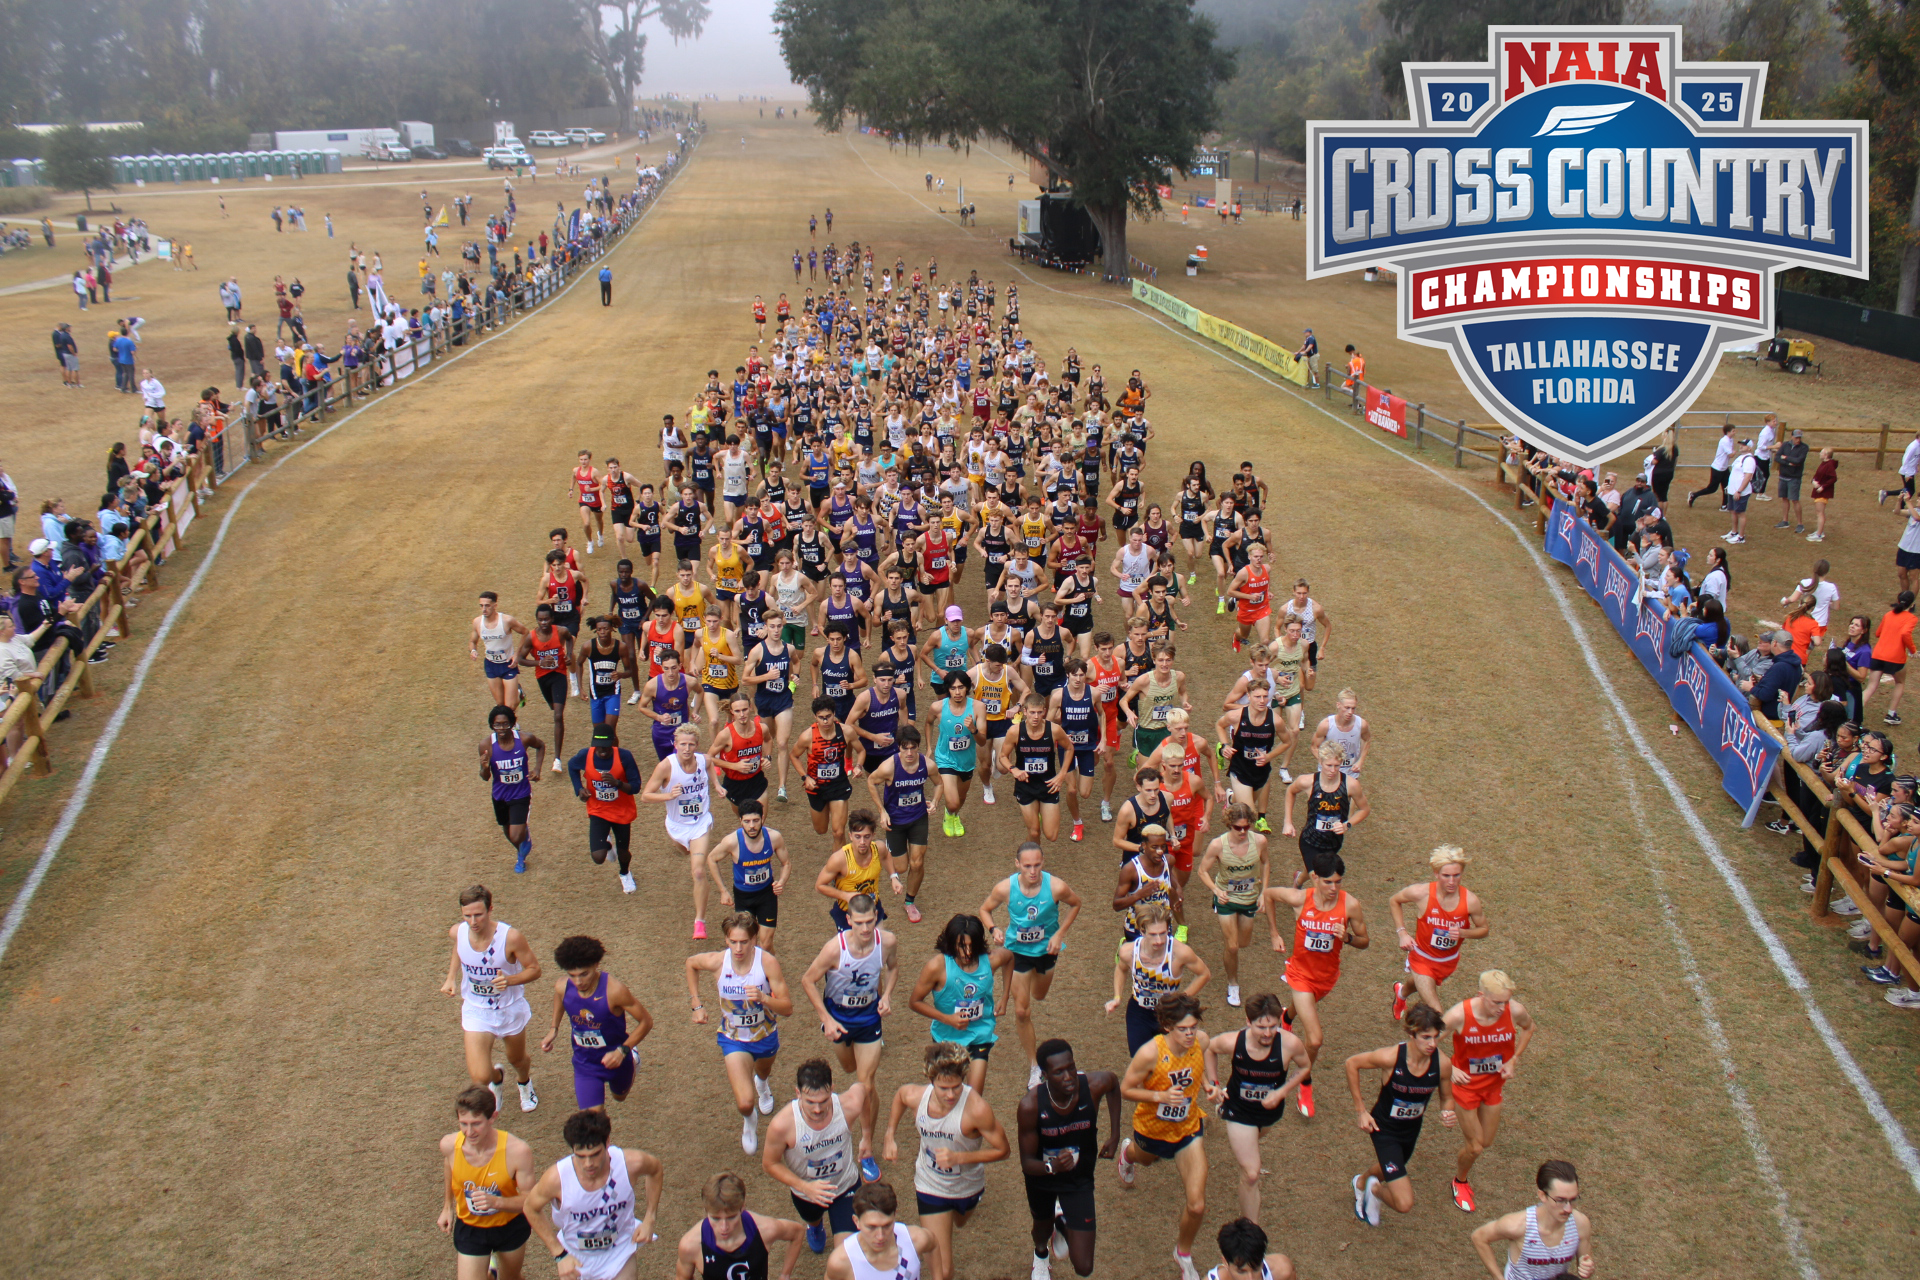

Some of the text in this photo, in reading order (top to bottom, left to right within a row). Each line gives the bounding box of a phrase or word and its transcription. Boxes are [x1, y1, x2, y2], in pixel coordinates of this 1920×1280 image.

[1674, 650, 1710, 728] NAIA
[1153, 695, 1174, 704] ROCKY
[870, 707, 898, 718] CARROLL
[953, 740, 967, 749] 637
[1721, 699, 1767, 798] NAIA
[496, 757, 524, 770] WILEY
[1028, 764, 1044, 772] 643
[821, 768, 837, 777] 652
[680, 782, 705, 794] AYLOR
[895, 777, 926, 788] CARROLL
[682, 804, 700, 814] 846
[1318, 801, 1341, 811] Park
[1227, 865, 1255, 873] ROCKY
[1426, 915, 1466, 928] MILLIGAN
[1020, 931, 1041, 941] 632
[1310, 938, 1330, 950] 703
[473, 984, 495, 994] 852
[847, 996, 868, 1006] 676
[739, 1013, 759, 1025] 737
[1464, 1032, 1513, 1044] MILLIGAN
[1162, 1105, 1186, 1118] 888
[803, 1134, 843, 1154] MONTREAT
[814, 1163, 837, 1176] 722
[570, 1201, 627, 1222] TAYLOR
